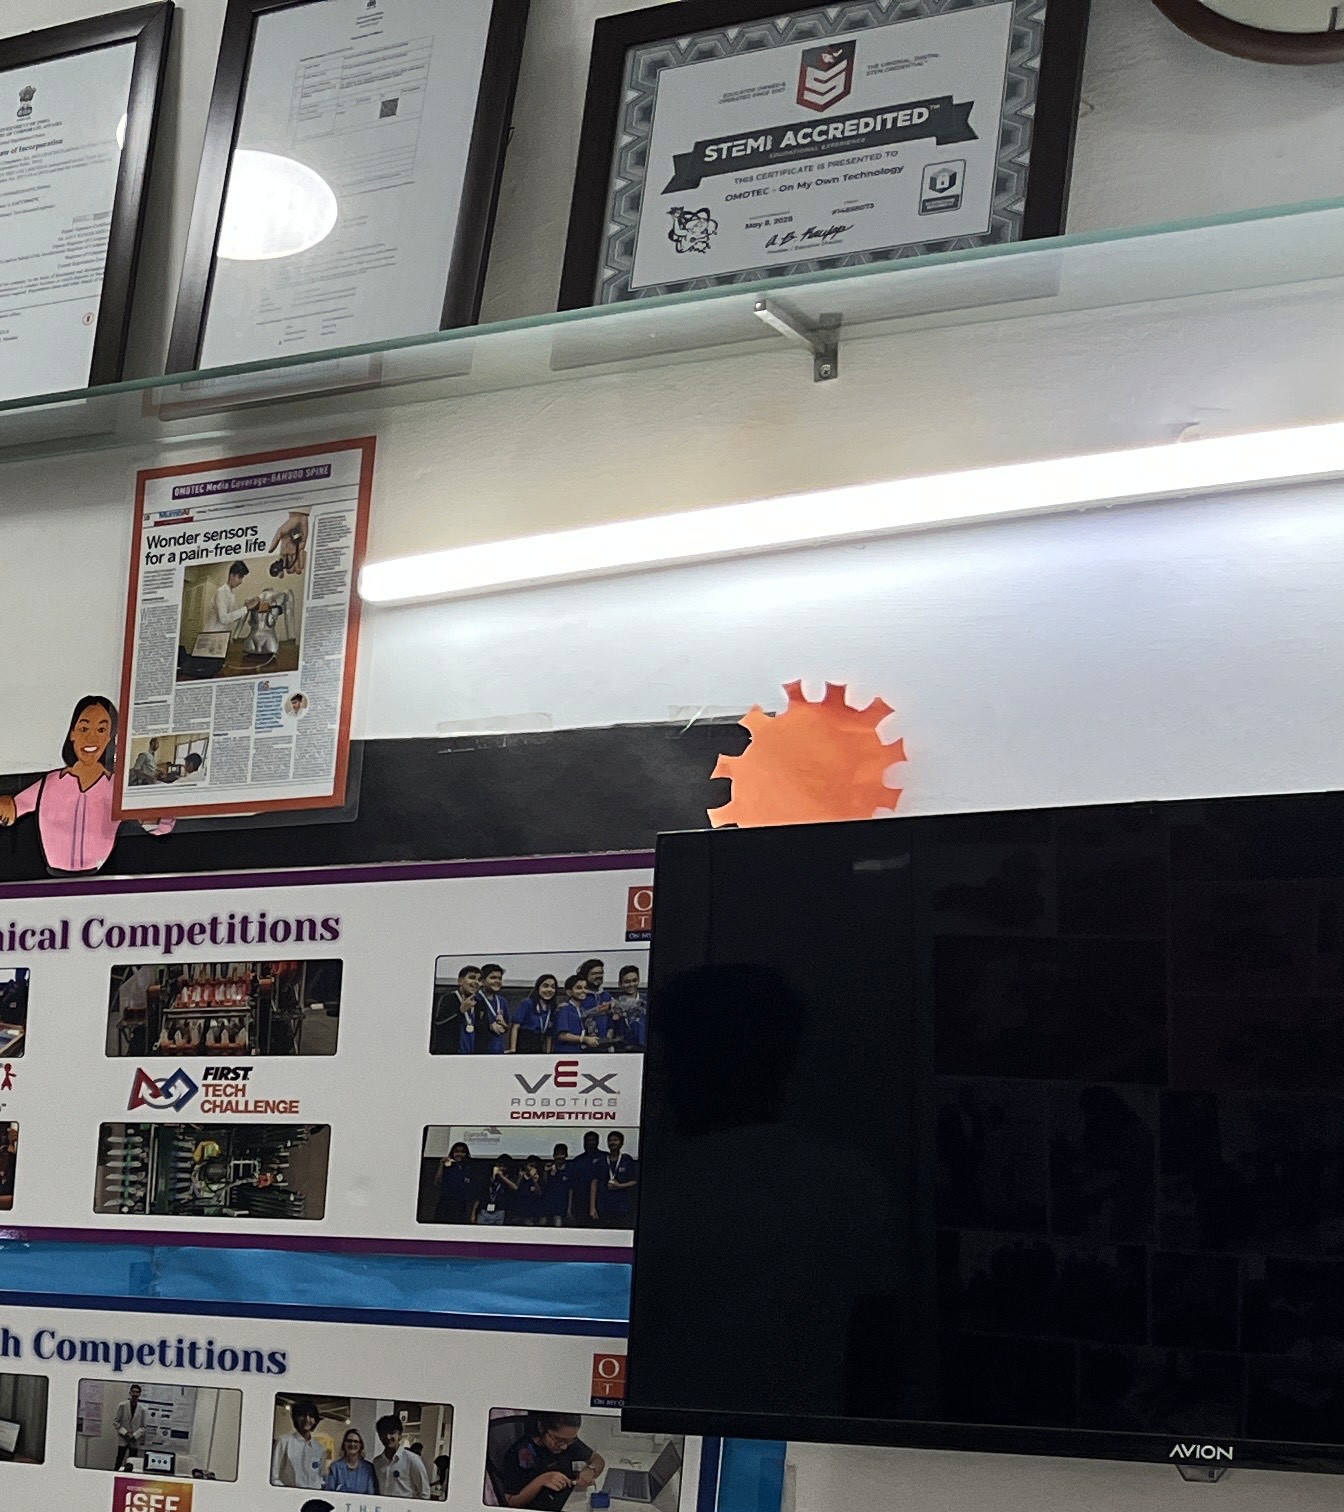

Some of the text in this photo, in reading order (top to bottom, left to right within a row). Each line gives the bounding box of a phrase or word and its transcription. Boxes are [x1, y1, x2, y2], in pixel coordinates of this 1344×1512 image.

[756, 153, 883, 181] CERTIFICATE PRESENTED
[725, 165, 905, 202] OMOTEC On My Own Technology
[206, 481, 229, 492] Media
[146, 524, 258, 549] Wonder sensors
[145, 538, 266, 566] for a pain-free life
[81, 911, 341, 954] Competitions
[513, 1060, 622, 1095] VEX
[202, 1083, 246, 1098] TECH
[511, 1096, 619, 1108] ROBOTICS
[200, 1098, 301, 1115] CHALLENGE
[510, 1110, 617, 1121] COMPETITION
[32, 1328, 288, 1376] Competitions
[1169, 1443, 1234, 1460] AVION
